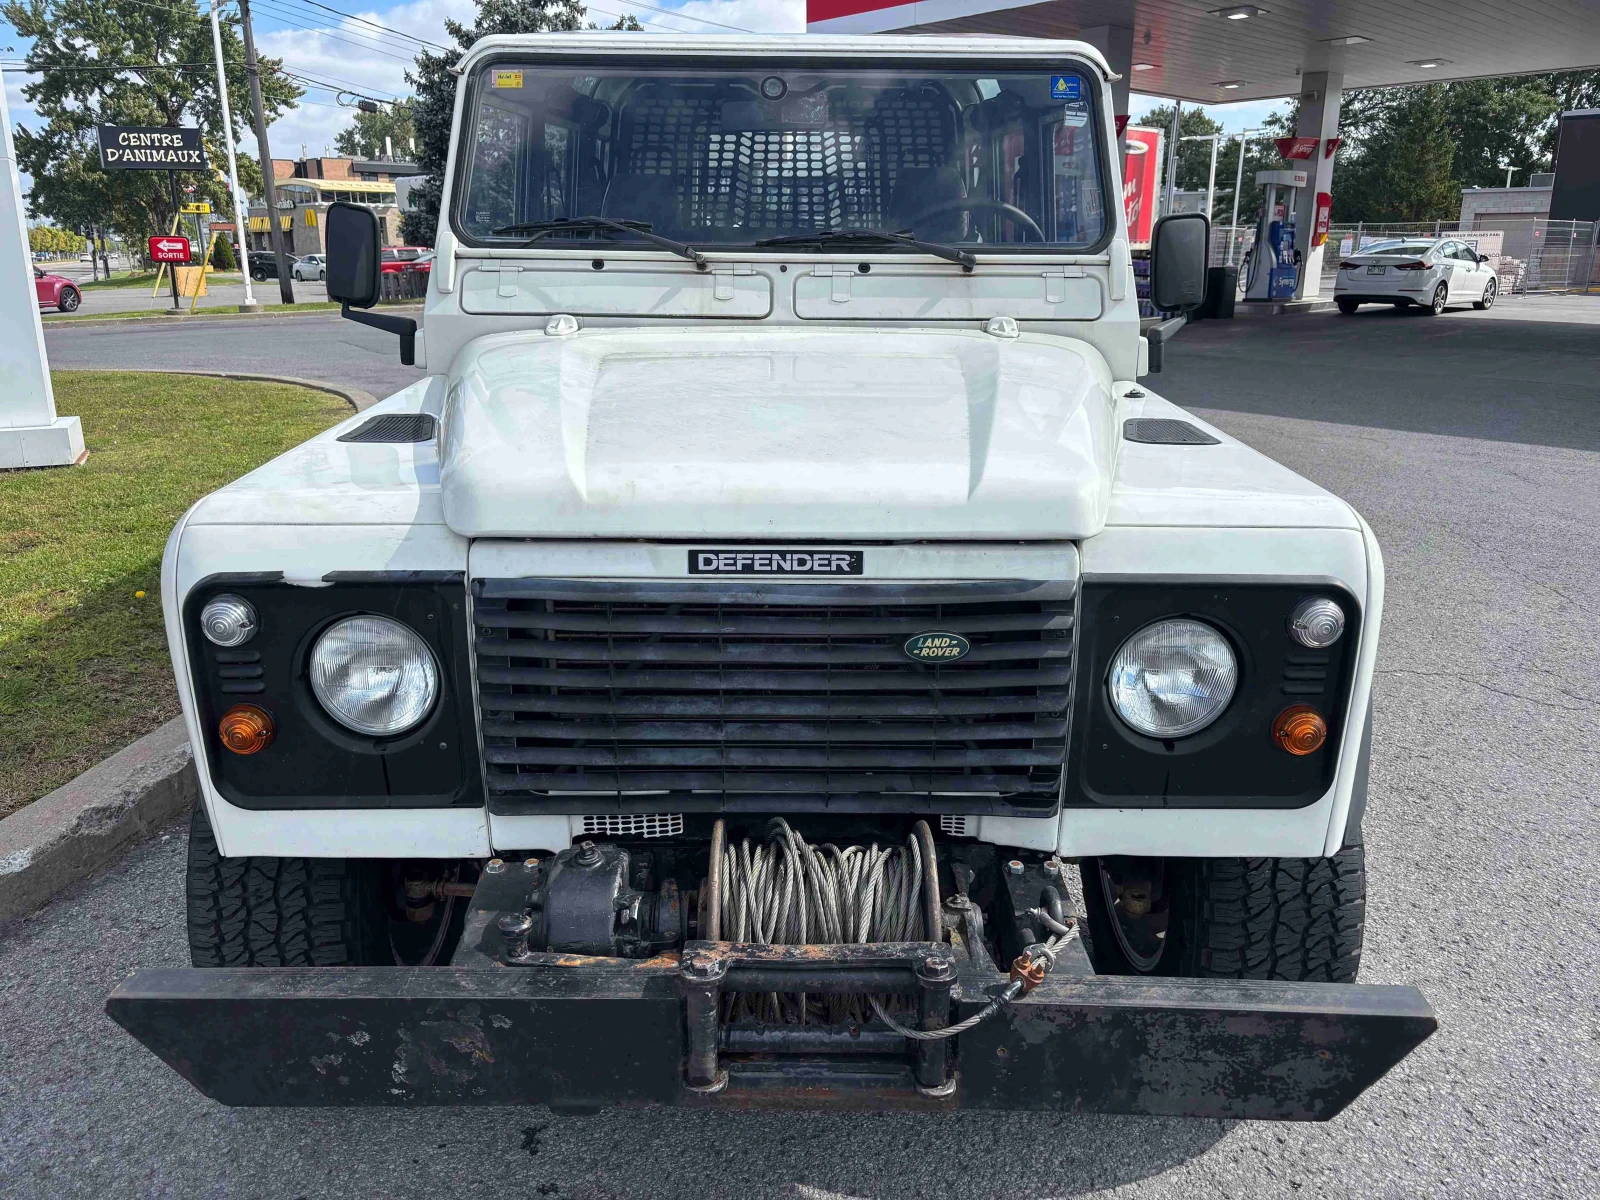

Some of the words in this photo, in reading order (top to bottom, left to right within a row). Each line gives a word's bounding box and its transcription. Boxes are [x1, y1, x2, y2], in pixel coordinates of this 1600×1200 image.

[1115, 121, 1120, 130] 2
[118, 132, 184, 147] CENTRE
[106, 148, 201, 163] D'ANIMAUX
[697, 552, 851, 572] DEFENDER
[917, 636, 950, 648] LAND
[920, 646, 961, 658] ROVER
